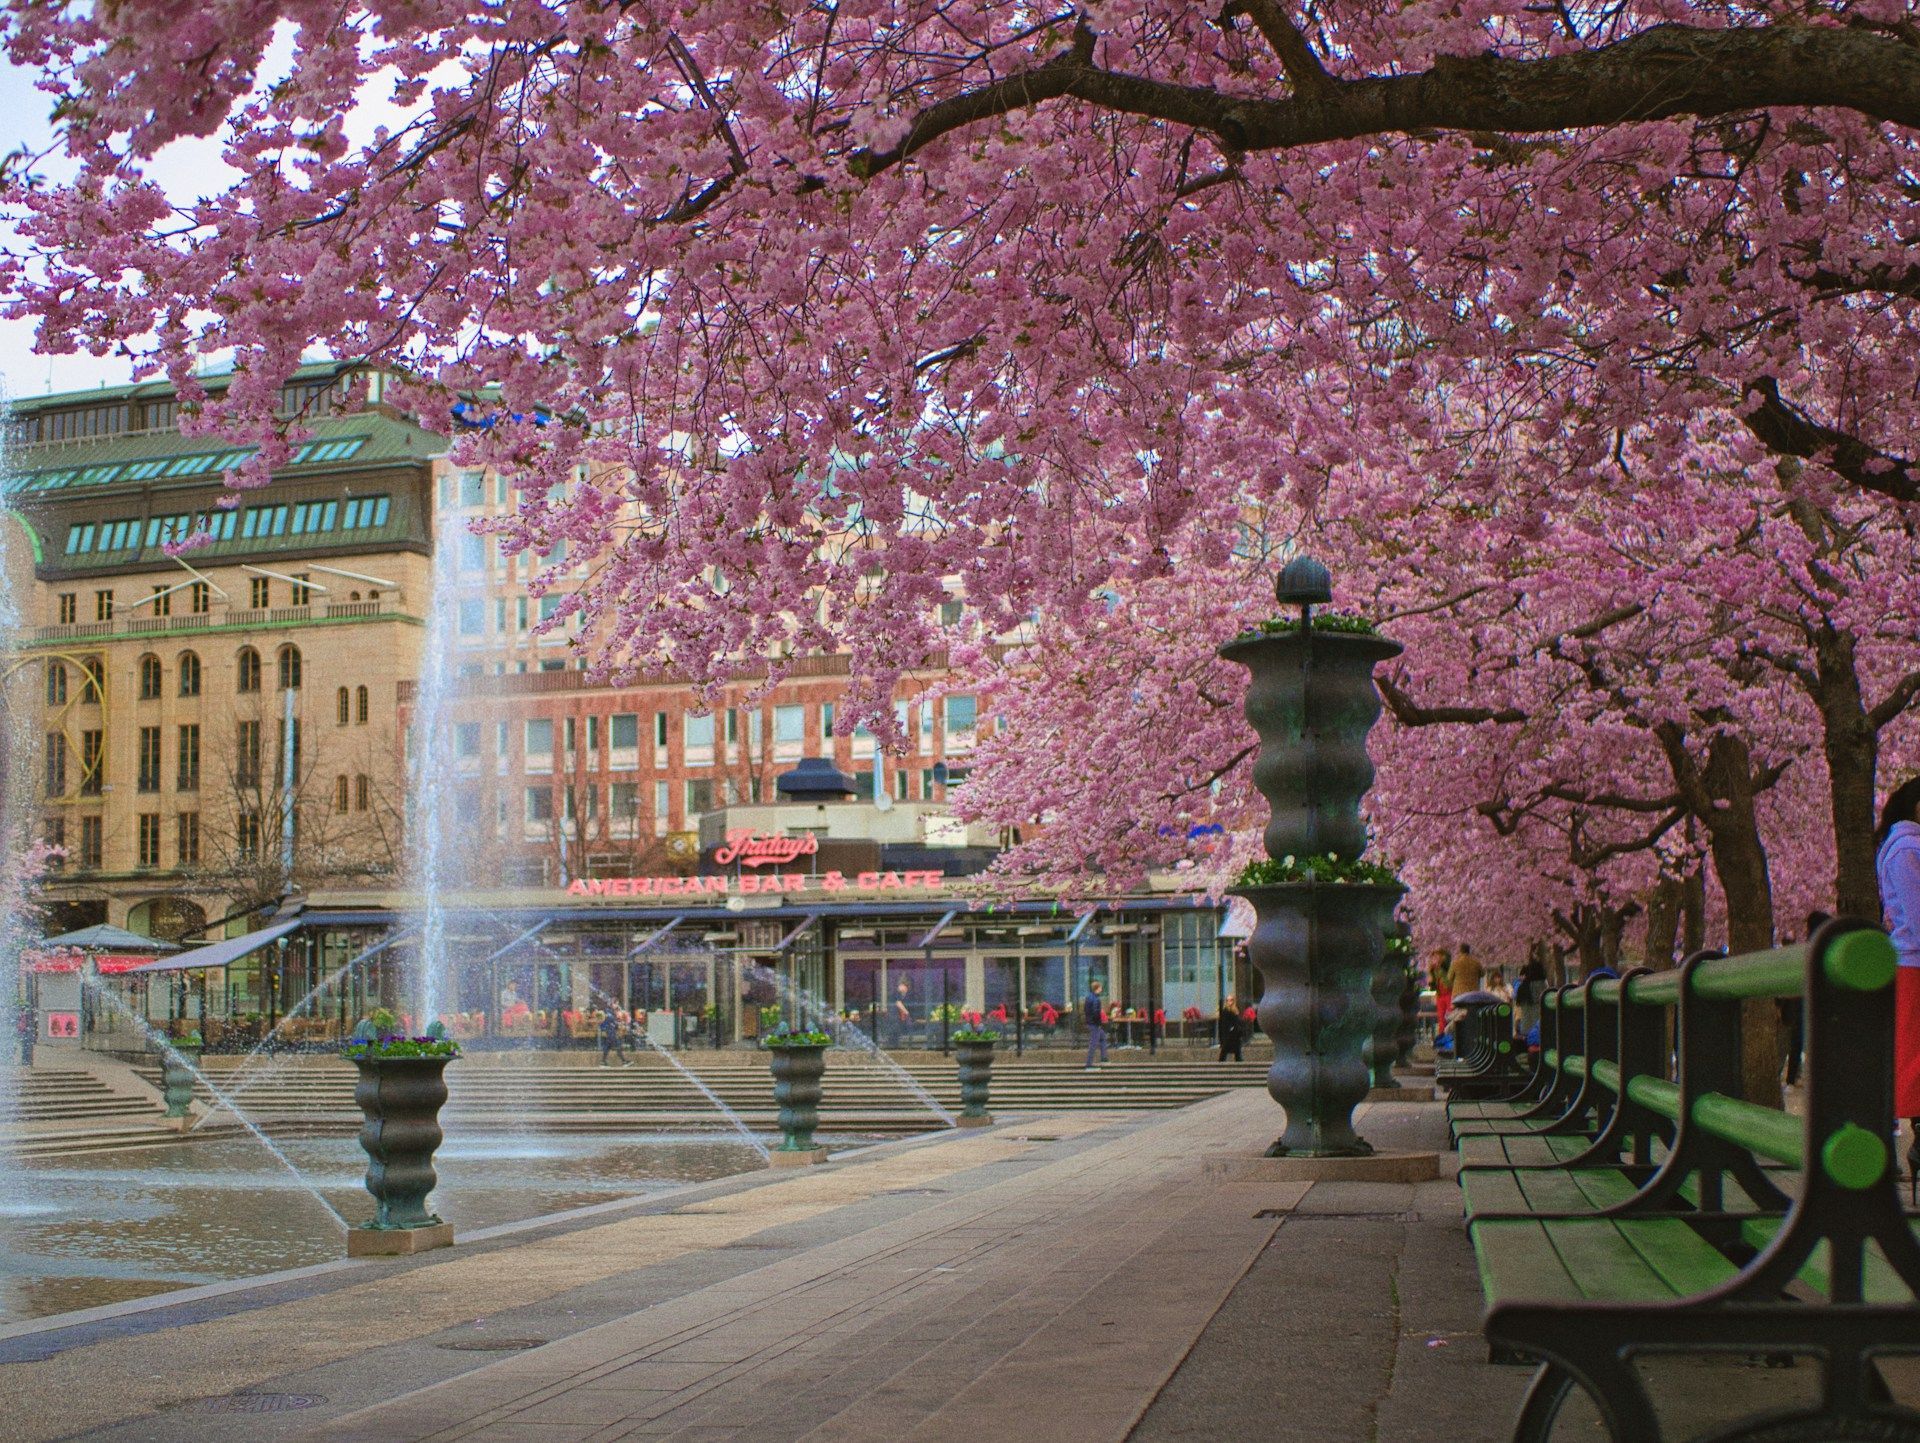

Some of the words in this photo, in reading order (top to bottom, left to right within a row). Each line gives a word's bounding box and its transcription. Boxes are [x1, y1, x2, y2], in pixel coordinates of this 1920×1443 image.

[715, 828, 818, 867] Friday's
[566, 875, 728, 896] AMERICAN
[739, 873, 806, 893] BAR
[821, 870, 848, 891] &
[857, 870, 944, 890] CAFE
